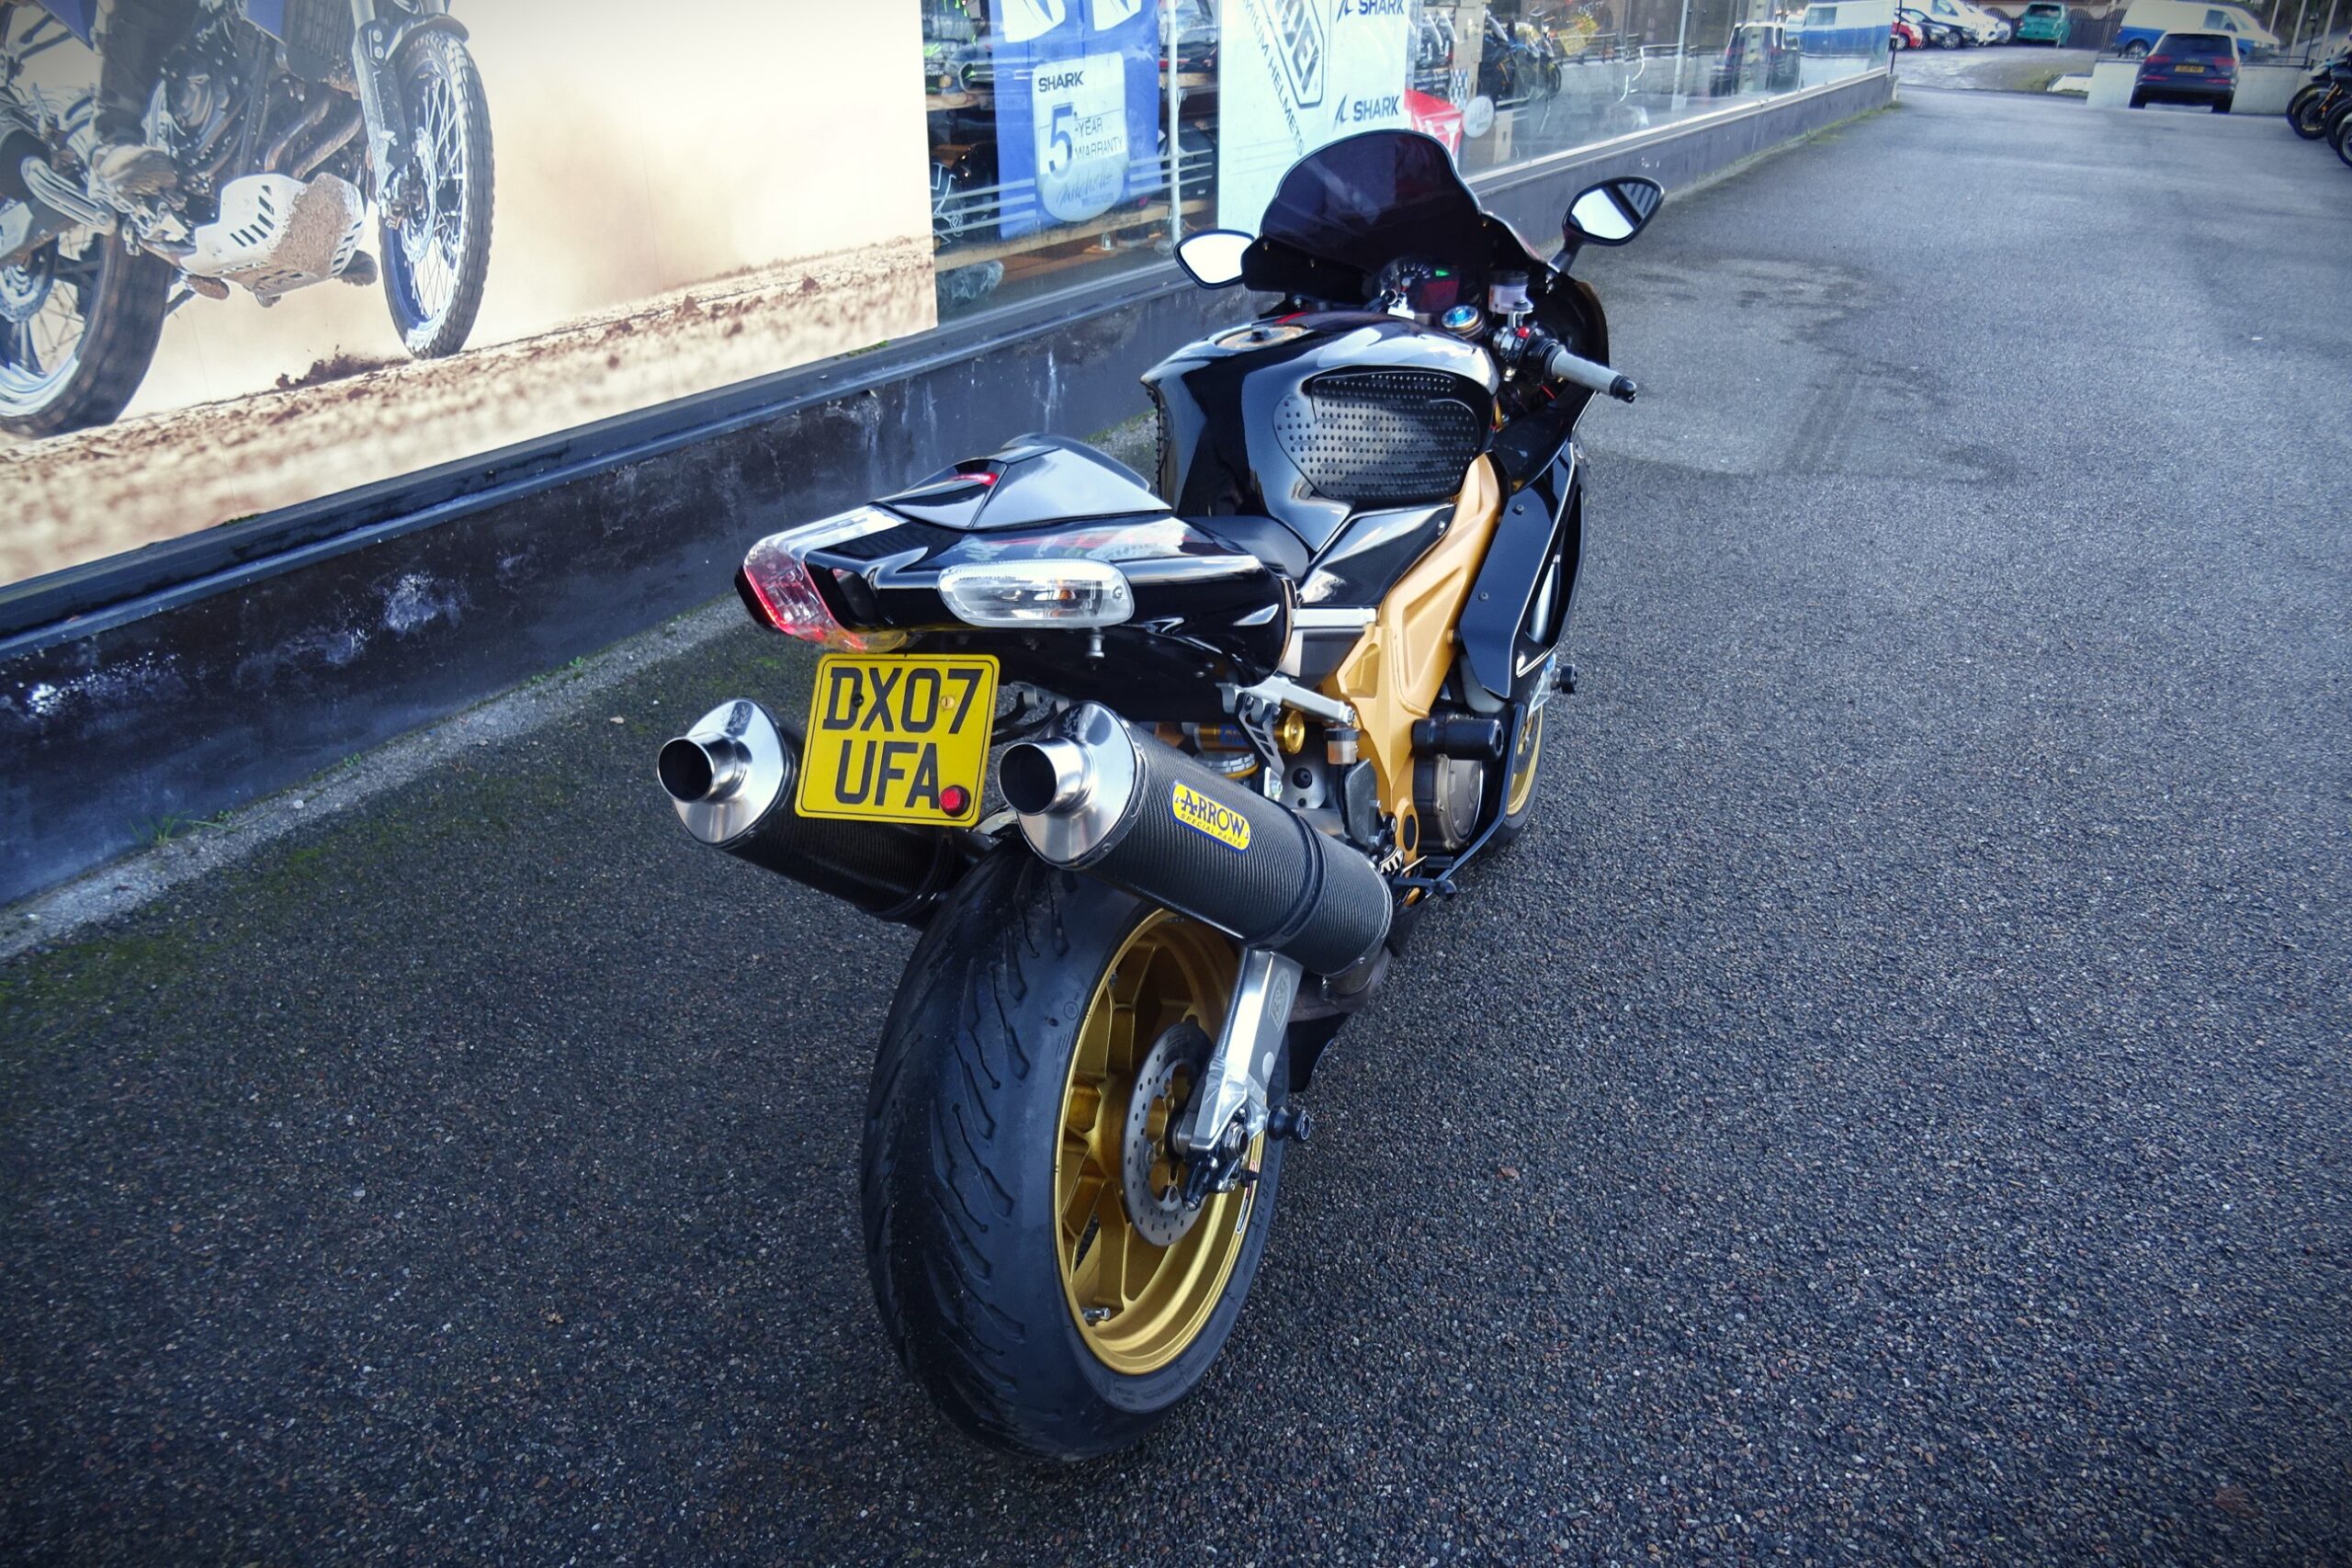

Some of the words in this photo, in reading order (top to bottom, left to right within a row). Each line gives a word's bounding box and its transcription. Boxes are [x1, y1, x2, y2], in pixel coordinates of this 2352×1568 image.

[1358, 0, 1405, 16] SHARK
[1275, 0, 1319, 94] OEI
[1038, 71, 1085, 93] SHARK
[1267, 57, 1305, 156] HELMETS
[1352, 95, 1400, 122] SHARK
[1074, 136, 1124, 160] WARRANTY
[821, 667, 985, 735] DX07
[834, 739, 940, 810] UFA
[1181, 790, 1245, 840] ARROW
[1181, 814, 1217, 836] SPECIAL
[1217, 831, 1242, 848] PARTS
